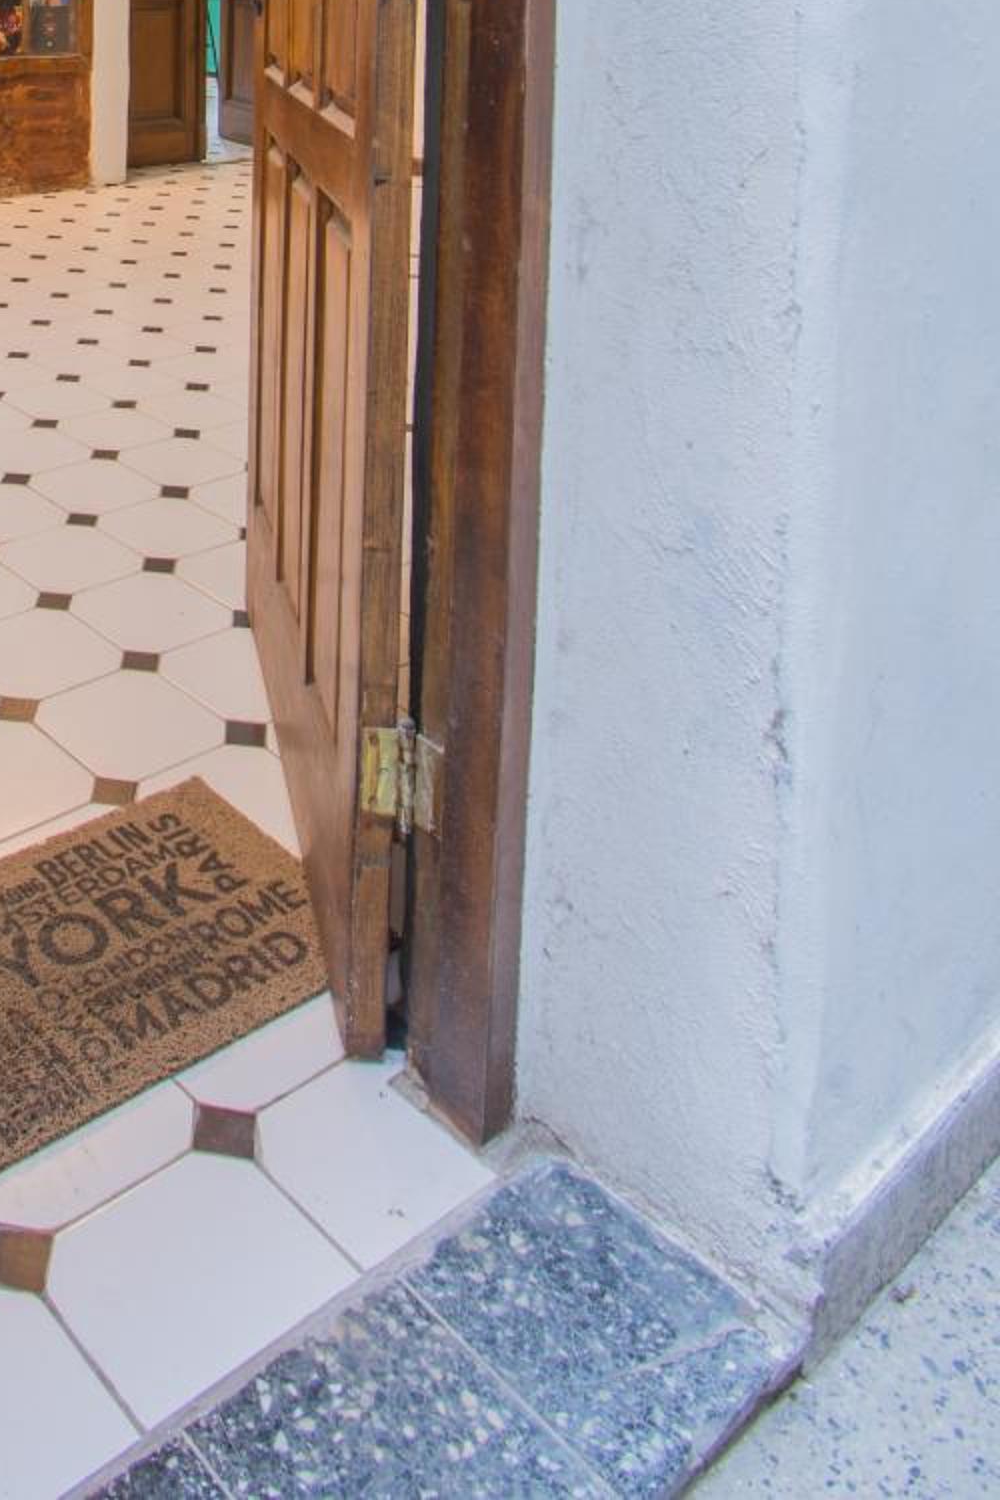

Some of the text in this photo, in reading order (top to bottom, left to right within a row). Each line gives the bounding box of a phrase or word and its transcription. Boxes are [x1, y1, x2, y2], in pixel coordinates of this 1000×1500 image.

[33, 821, 151, 887] BERLIN
[147, 811, 249, 893] PARIS
[191, 878, 306, 954] ROME
[71, 927, 191, 997] LONDON
[105, 925, 309, 1052] MADRID
